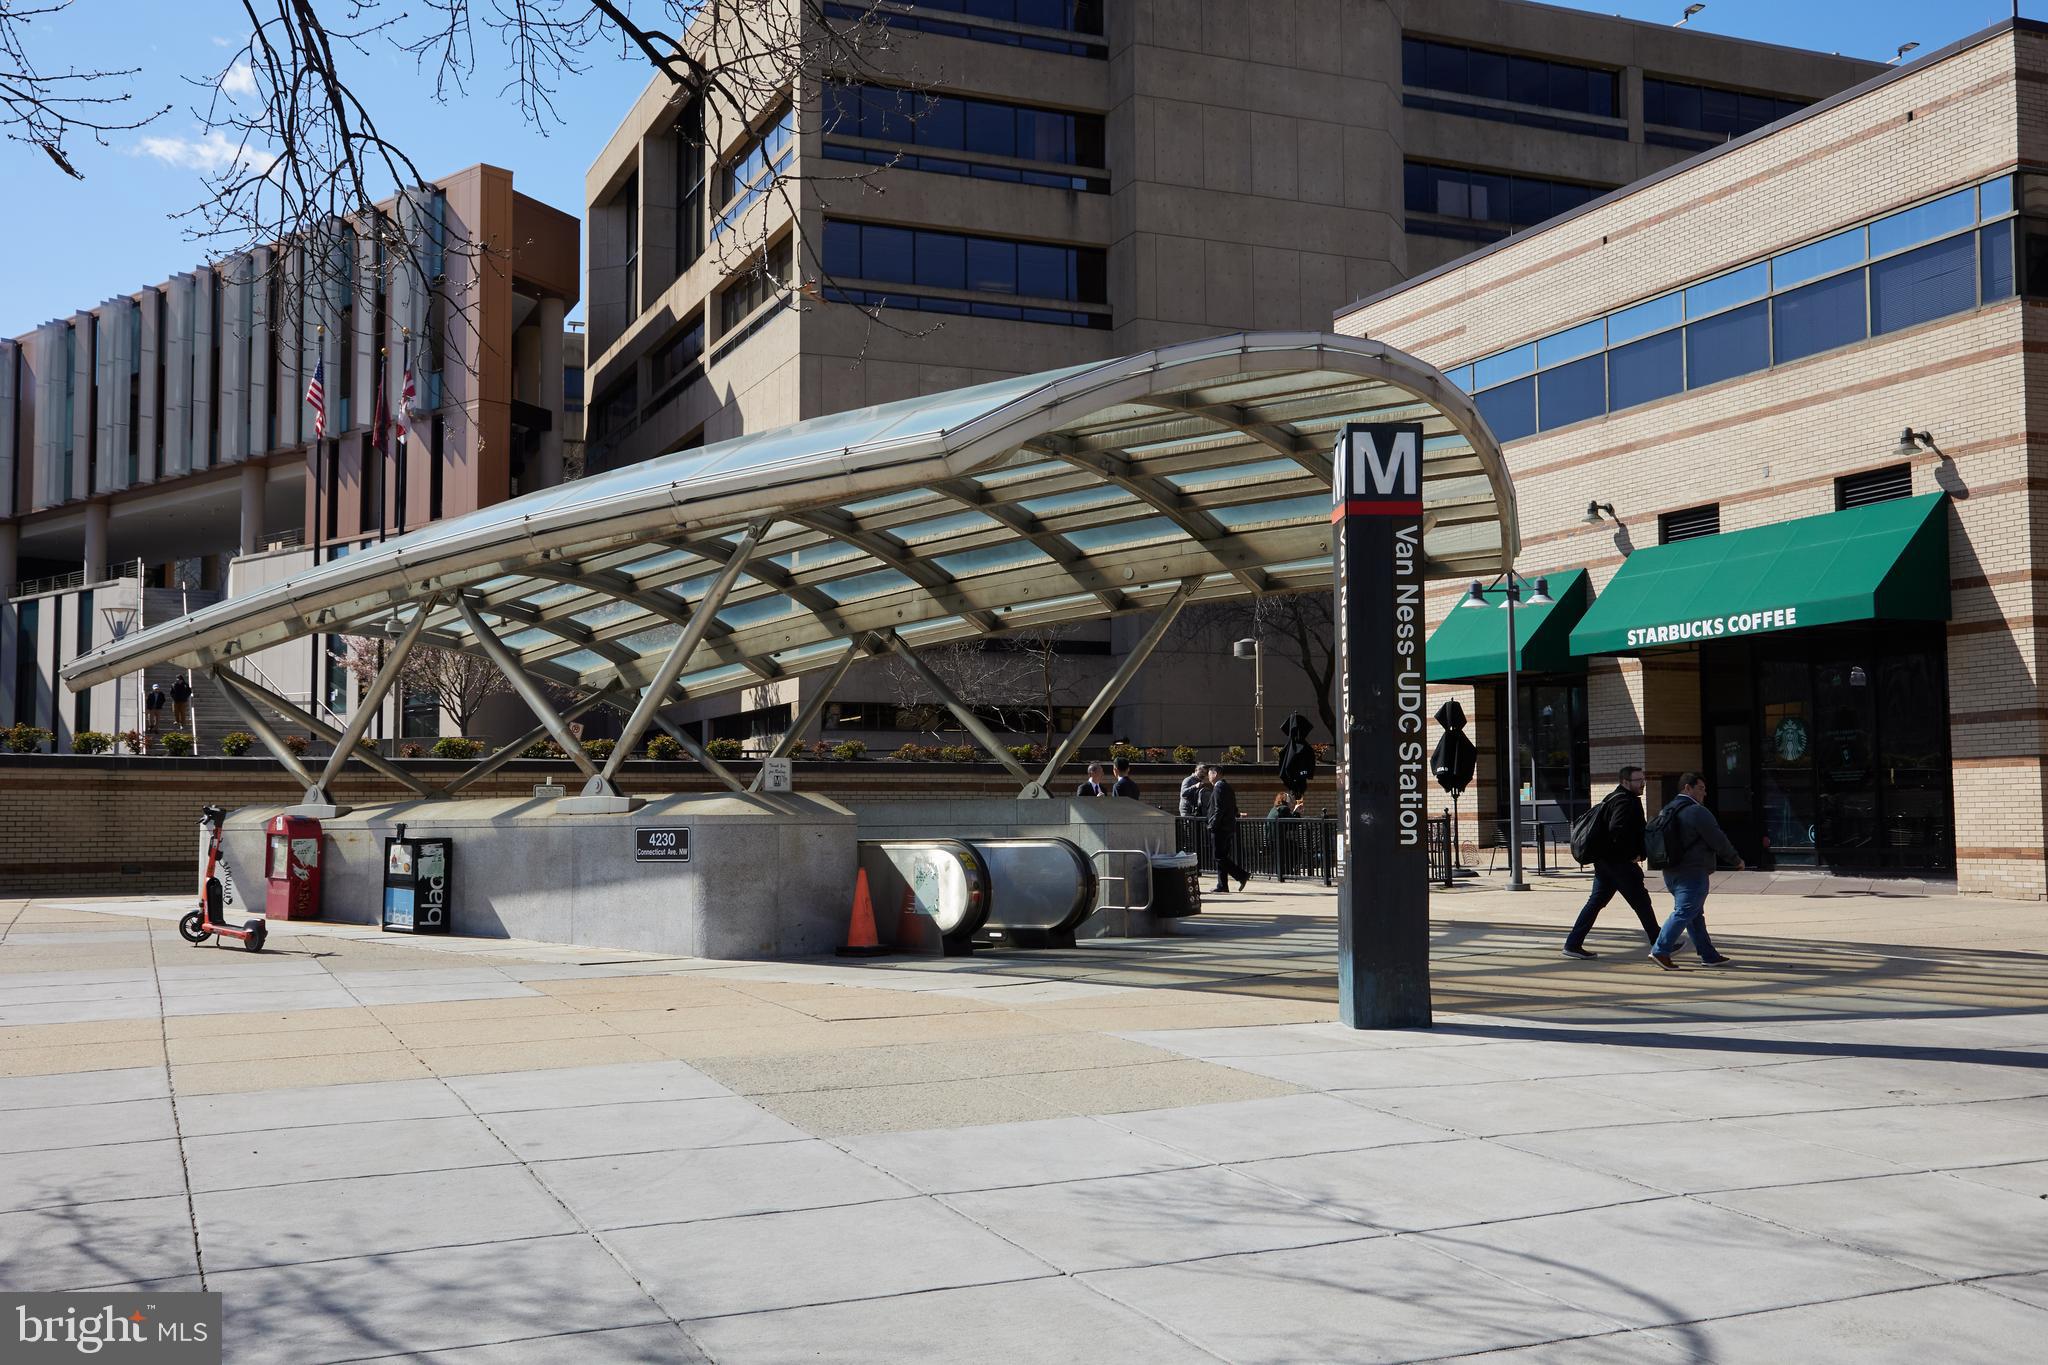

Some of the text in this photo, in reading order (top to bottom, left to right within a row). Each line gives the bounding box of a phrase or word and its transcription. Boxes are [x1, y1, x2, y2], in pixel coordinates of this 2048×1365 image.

[1353, 431, 1417, 495] M
[1627, 607, 1797, 646] STARBUCKS COFFEE
[1395, 524, 1423, 845] Van Ness-UDC Station
[637, 848, 688, 856] Connecticut Ave. NW
[648, 832, 676, 846] 4230
